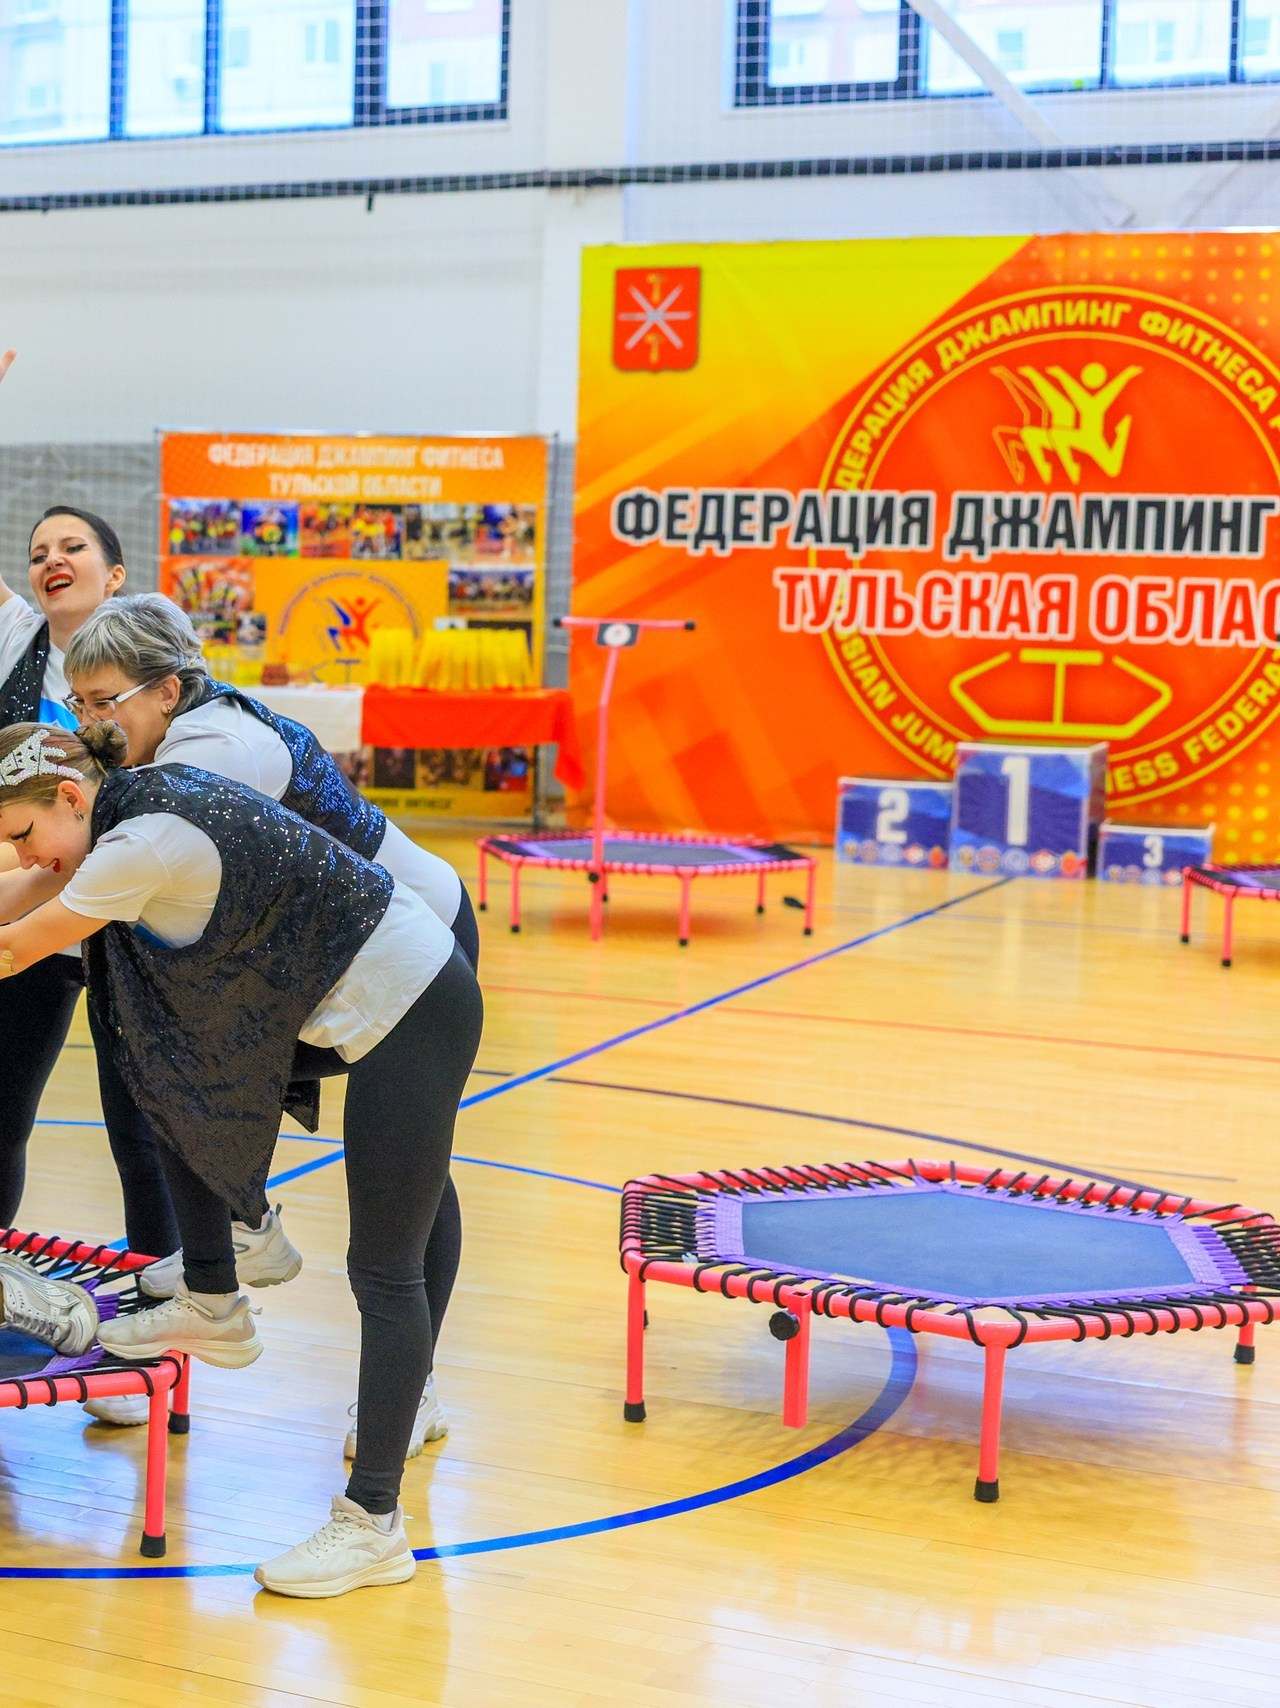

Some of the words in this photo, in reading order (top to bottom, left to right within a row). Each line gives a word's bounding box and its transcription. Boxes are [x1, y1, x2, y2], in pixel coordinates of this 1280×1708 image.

[835, 357, 934, 492] ДЕРАЦИЯ
[935, 299, 1132, 371] ДЖАМПИНГ
[1138, 310, 1278, 414] ФИТНЕСА
[613, 489, 933, 556] ФЕДЕРАЦИЯ
[945, 493, 1278, 560] ДЖАМПИНГ
[776, 569, 1075, 639] ТУЛЬСКАЯ
[837, 629, 897, 711] SIAN
[890, 710, 958, 771] JUM
[1182, 648, 1280, 764] FEDERA
[875, 787, 910, 845] 2
[1001, 755, 1030, 847] 1
[1142, 835, 1164, 868] 3
